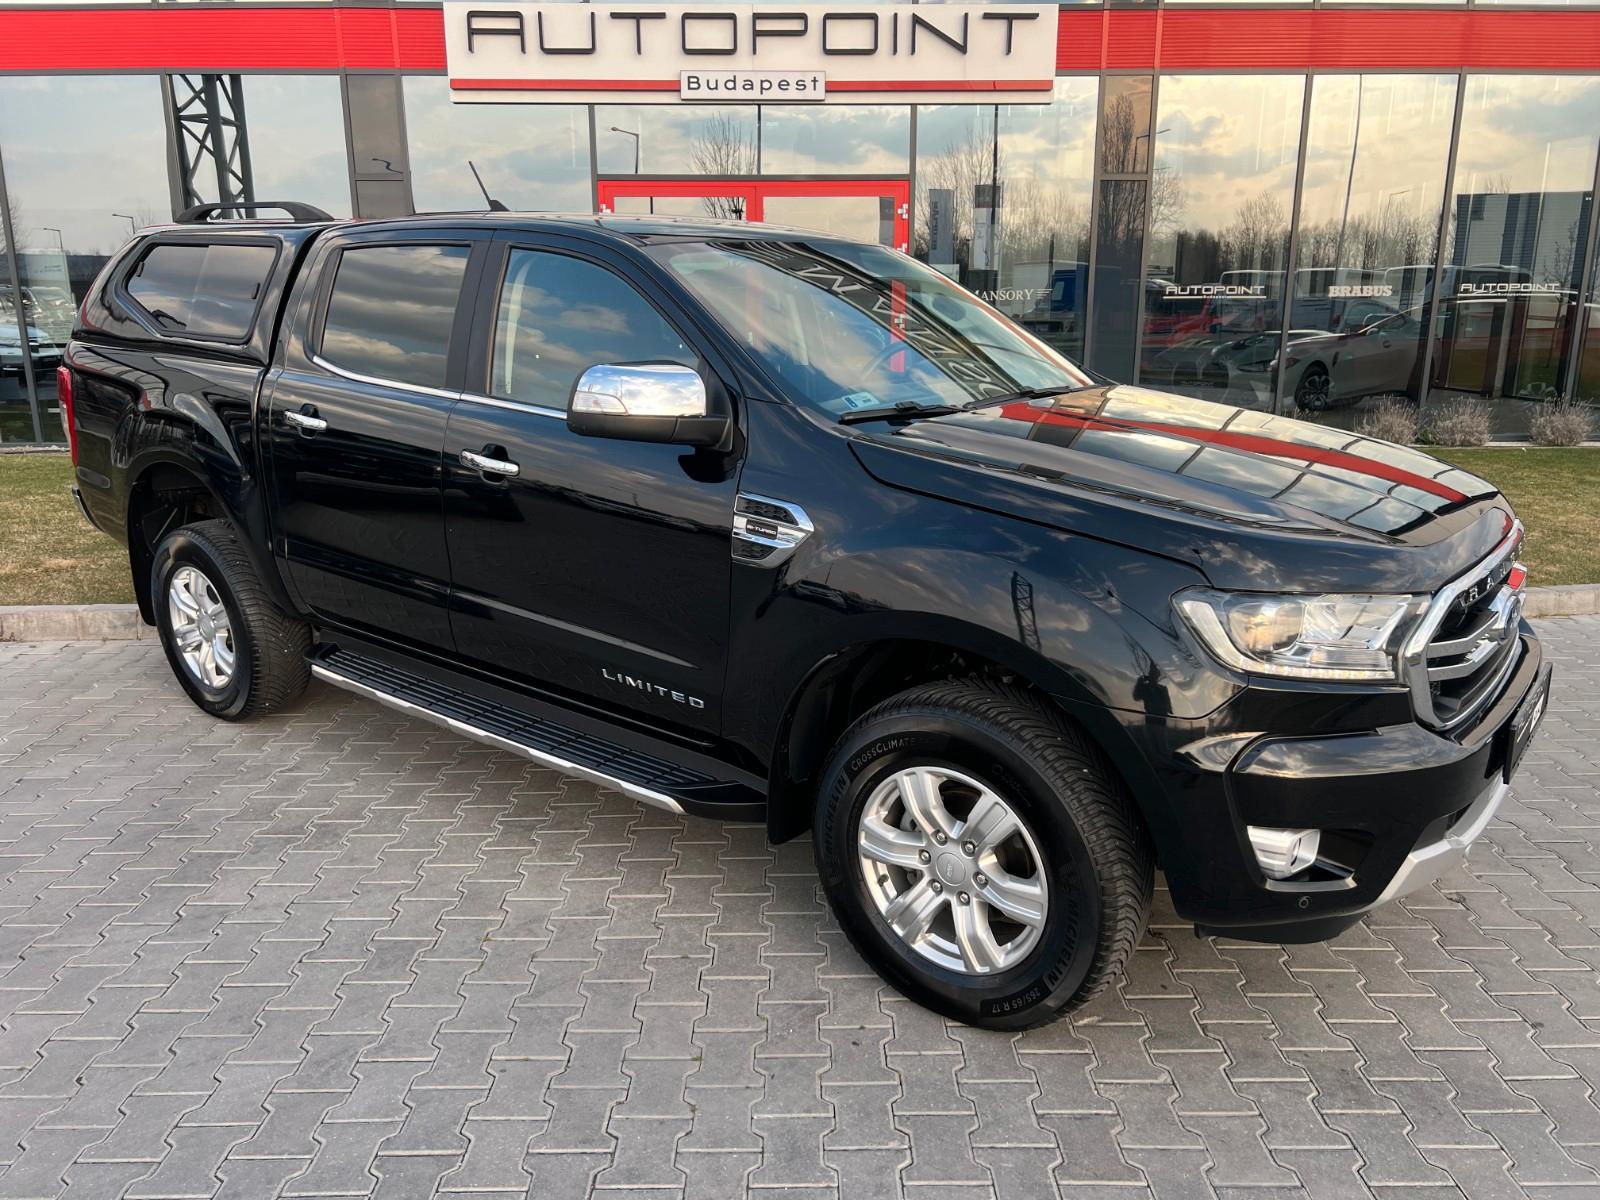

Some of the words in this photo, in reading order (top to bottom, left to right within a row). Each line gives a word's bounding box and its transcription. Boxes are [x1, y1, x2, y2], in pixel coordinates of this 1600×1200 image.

[467, 11, 1040, 56] AUTOPOINT
[686, 75, 819, 96] Budapest
[1165, 285, 1265, 295] AUTOPOINT
[1328, 285, 1392, 297] BRABUS
[1460, 283, 1560, 292] AUTOPOINT
[602, 668, 704, 708] LIMITED
